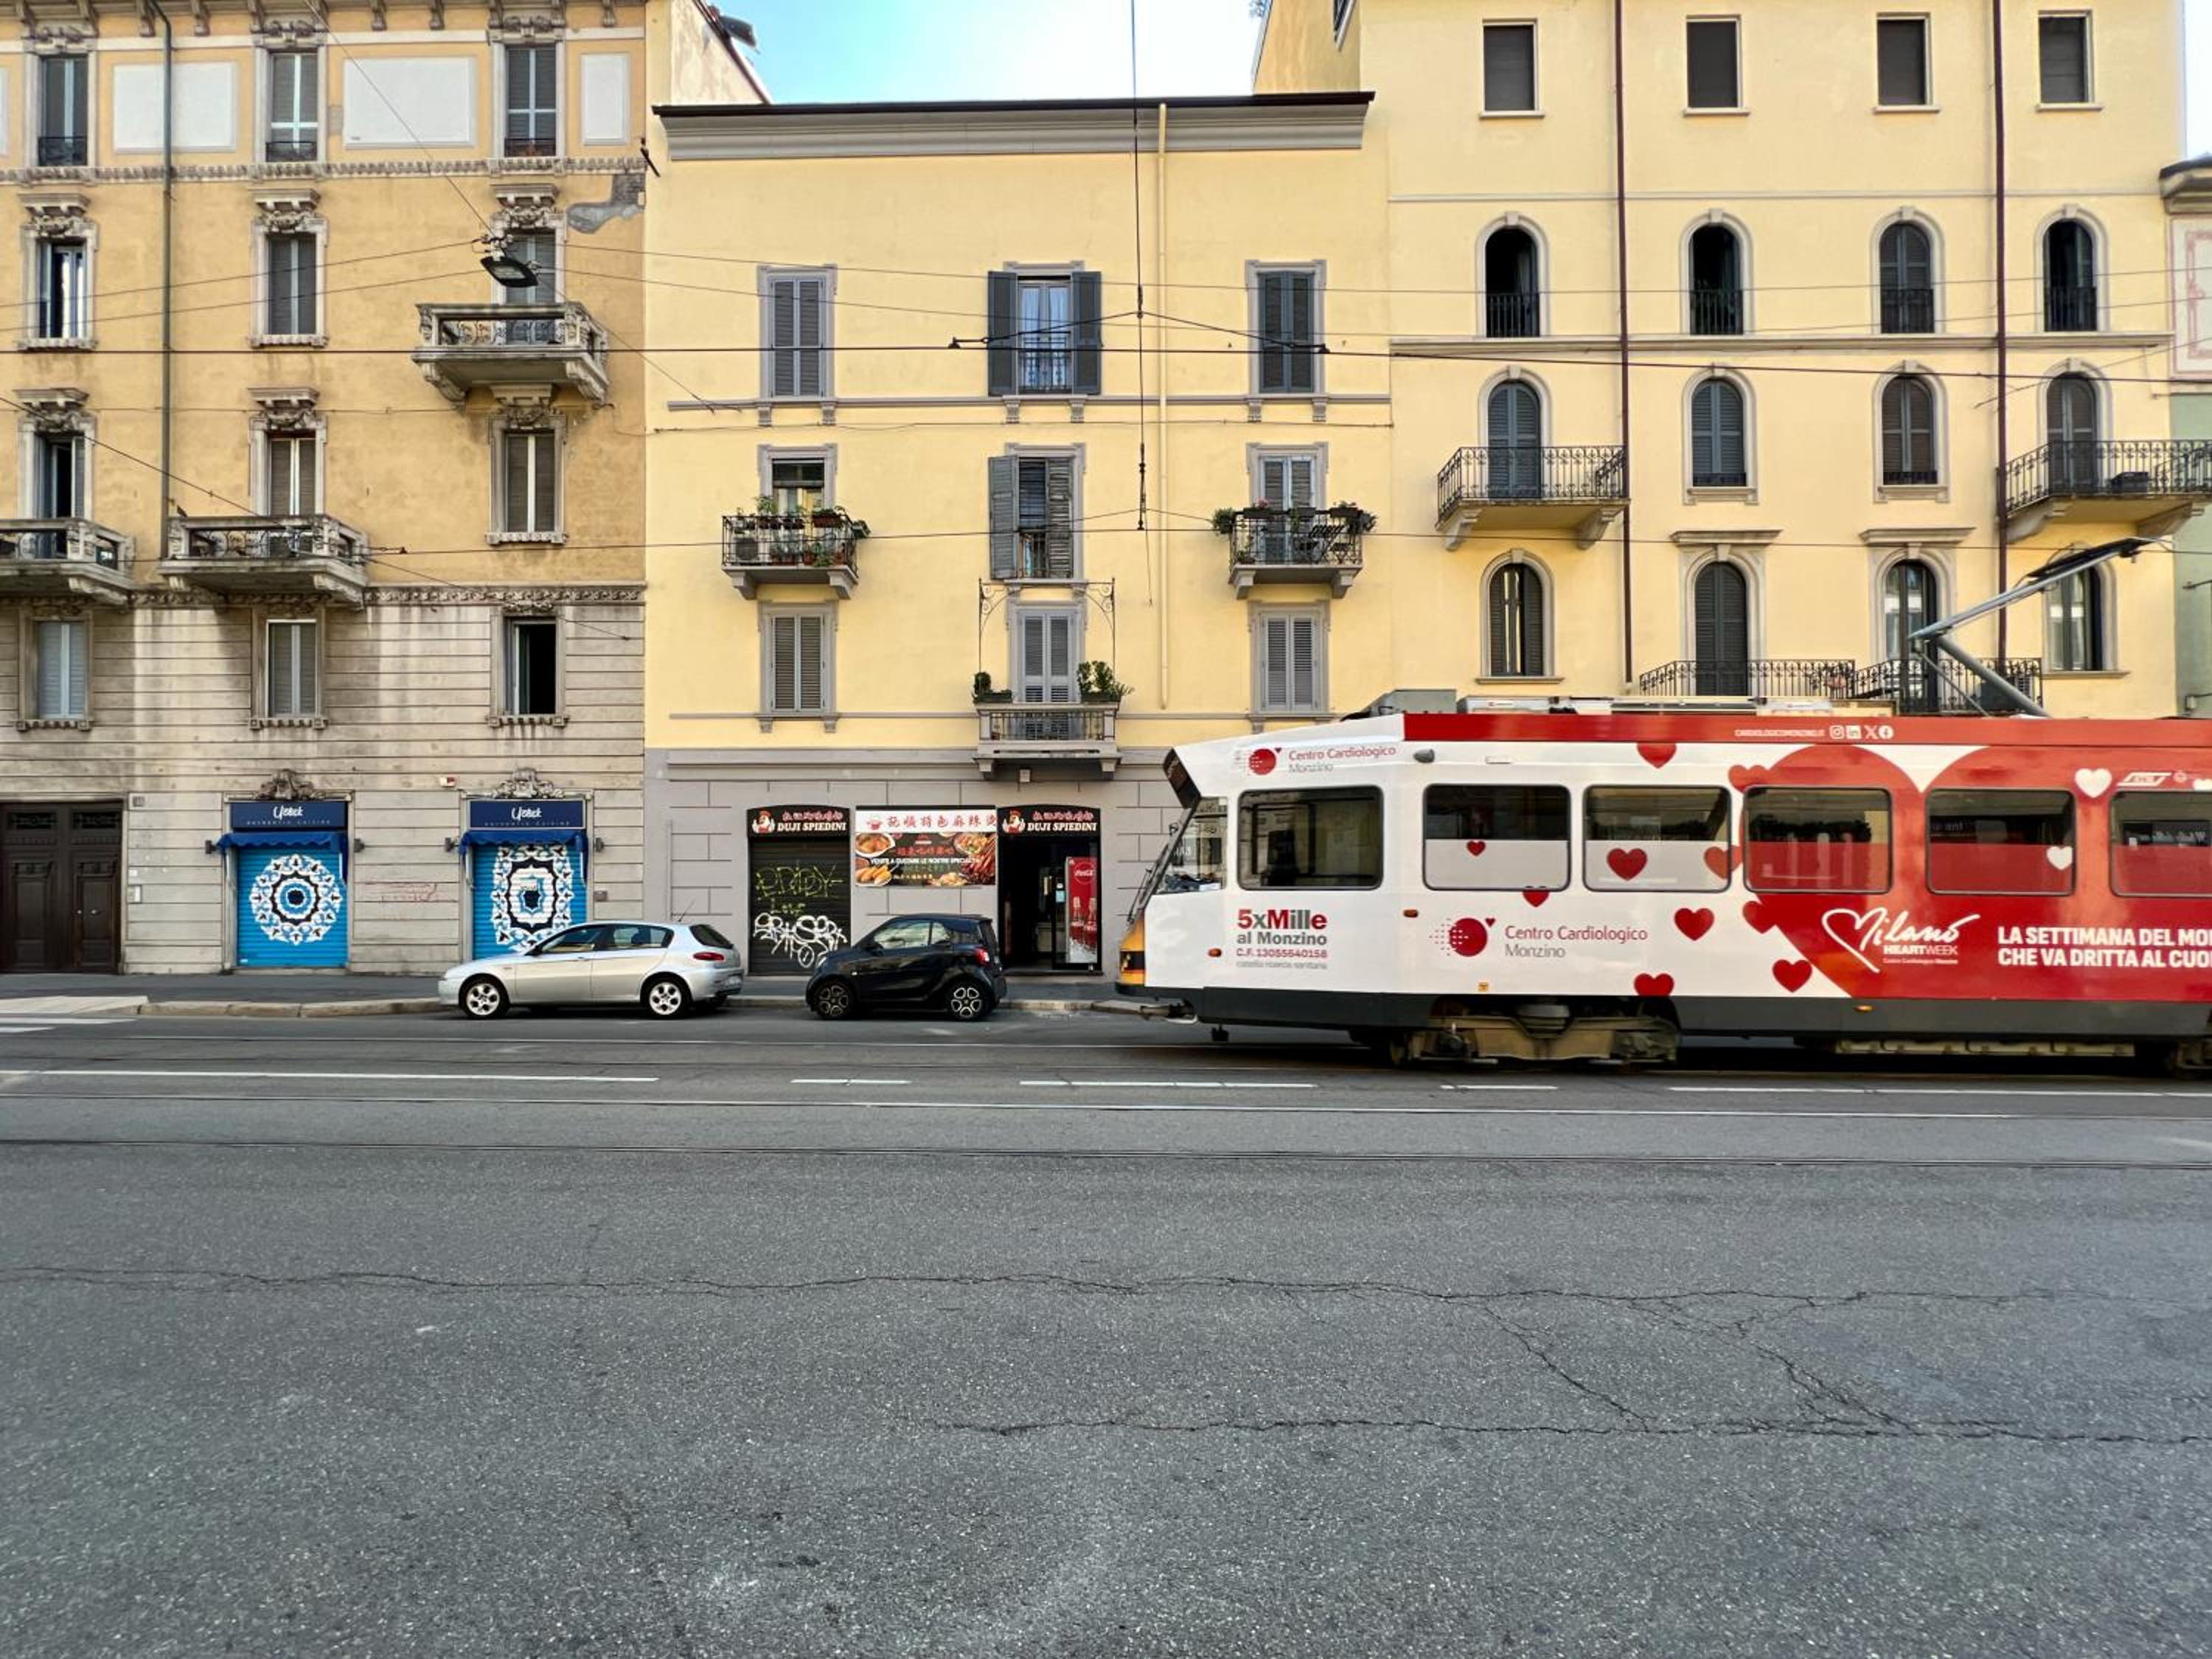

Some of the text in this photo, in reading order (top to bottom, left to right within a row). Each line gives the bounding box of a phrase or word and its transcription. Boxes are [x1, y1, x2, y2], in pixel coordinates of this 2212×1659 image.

[1289, 746, 1397, 761] Centro Cardiologico
[1289, 763, 1334, 773] Monzino
[777, 822, 846, 831] DUJI SPIEDINI
[1027, 822, 1097, 831] DUJI SPIEDINI
[1238, 909, 1327, 929] 5xMille
[1237, 931, 1327, 945] al Monzino
[1505, 925, 1648, 944] Centro Cardiologico
[1822, 907, 1980, 973] Milano
[1997, 927, 2212, 946] LA SETTIMANA DEL MO
[1505, 944, 1566, 958] Monzino
[1883, 945, 1958, 955] HEARTWEEK
[1997, 948, 2212, 967] CHE VA DRITTA AL CUO
